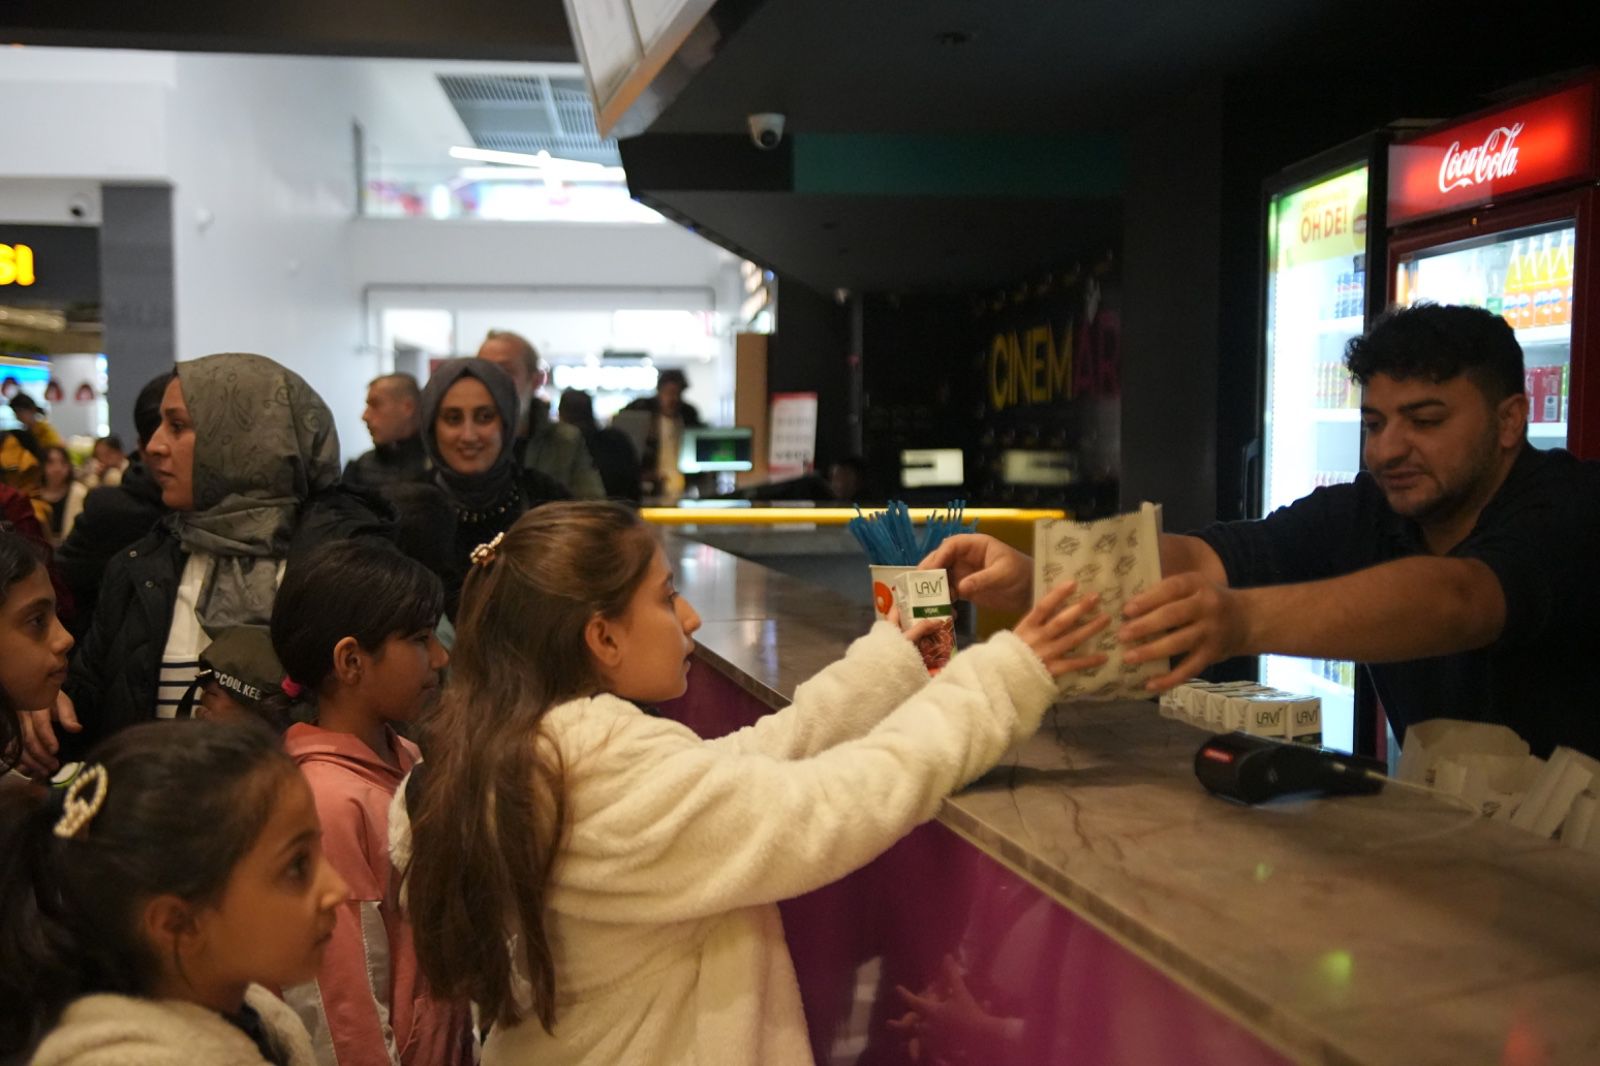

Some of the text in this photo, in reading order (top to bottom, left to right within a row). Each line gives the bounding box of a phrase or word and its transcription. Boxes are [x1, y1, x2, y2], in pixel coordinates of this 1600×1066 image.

[1301, 205, 1348, 244] OH DE!
[219, 673, 242, 693] COOL
